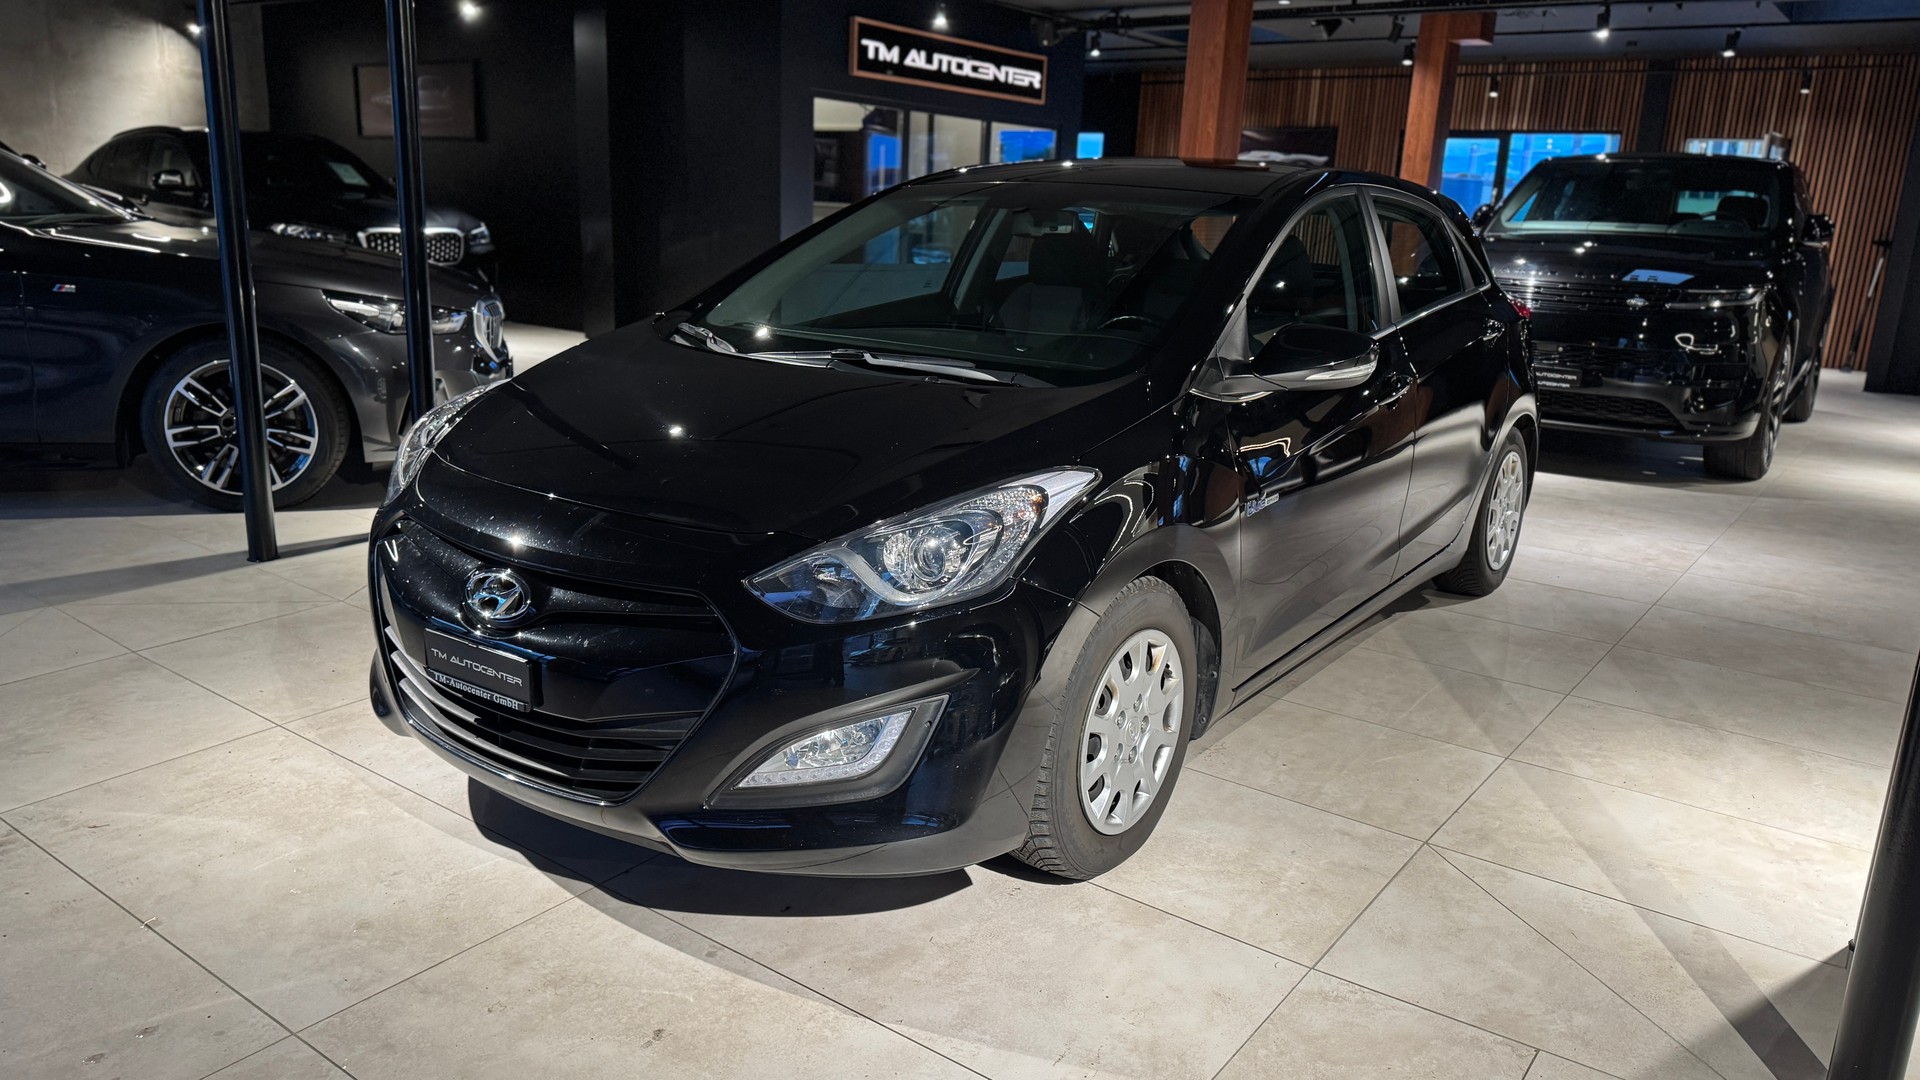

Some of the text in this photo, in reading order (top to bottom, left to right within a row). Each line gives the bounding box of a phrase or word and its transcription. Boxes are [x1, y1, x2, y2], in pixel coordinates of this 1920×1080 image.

[861, 38, 1041, 89] TM AUTOCENTER
[431, 647, 523, 687] TM AUTOCENTER
[433, 671, 519, 711] TM-Autocenter GmbH
